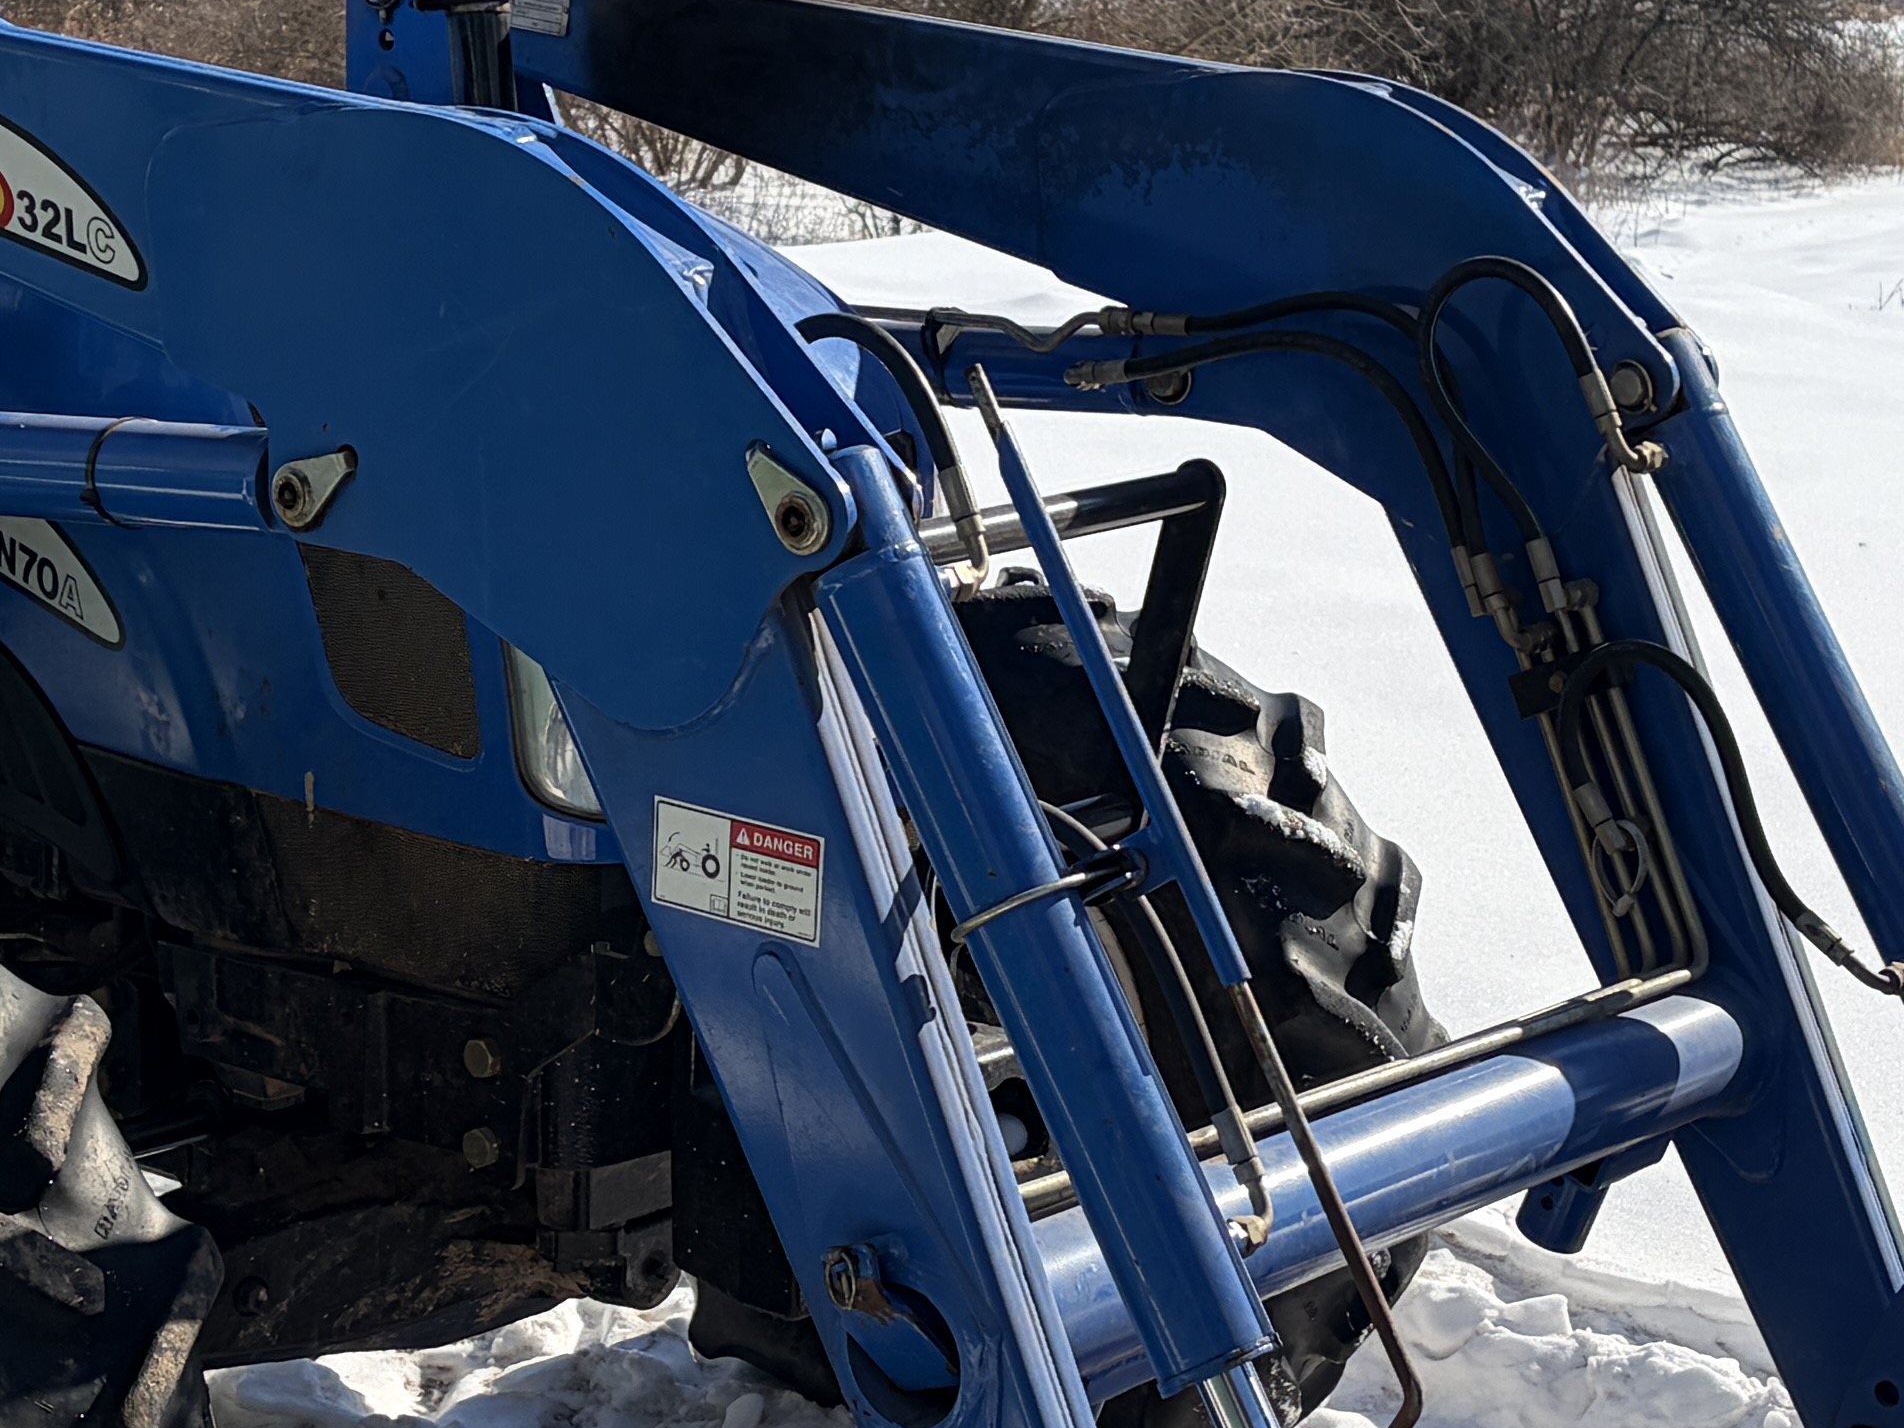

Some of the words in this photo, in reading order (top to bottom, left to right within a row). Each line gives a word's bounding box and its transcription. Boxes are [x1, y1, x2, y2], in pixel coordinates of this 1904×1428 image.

[17, 189, 116, 265] 32LC
[753, 832, 813, 860] DANGER
[737, 901, 757, 911] result
[759, 905, 765, 914] in
[768, 908, 787, 919] death
[738, 891, 761, 903] Failure
[763, 898, 770, 906] to
[772, 901, 797, 914] comply
[799, 908, 811, 916] will
